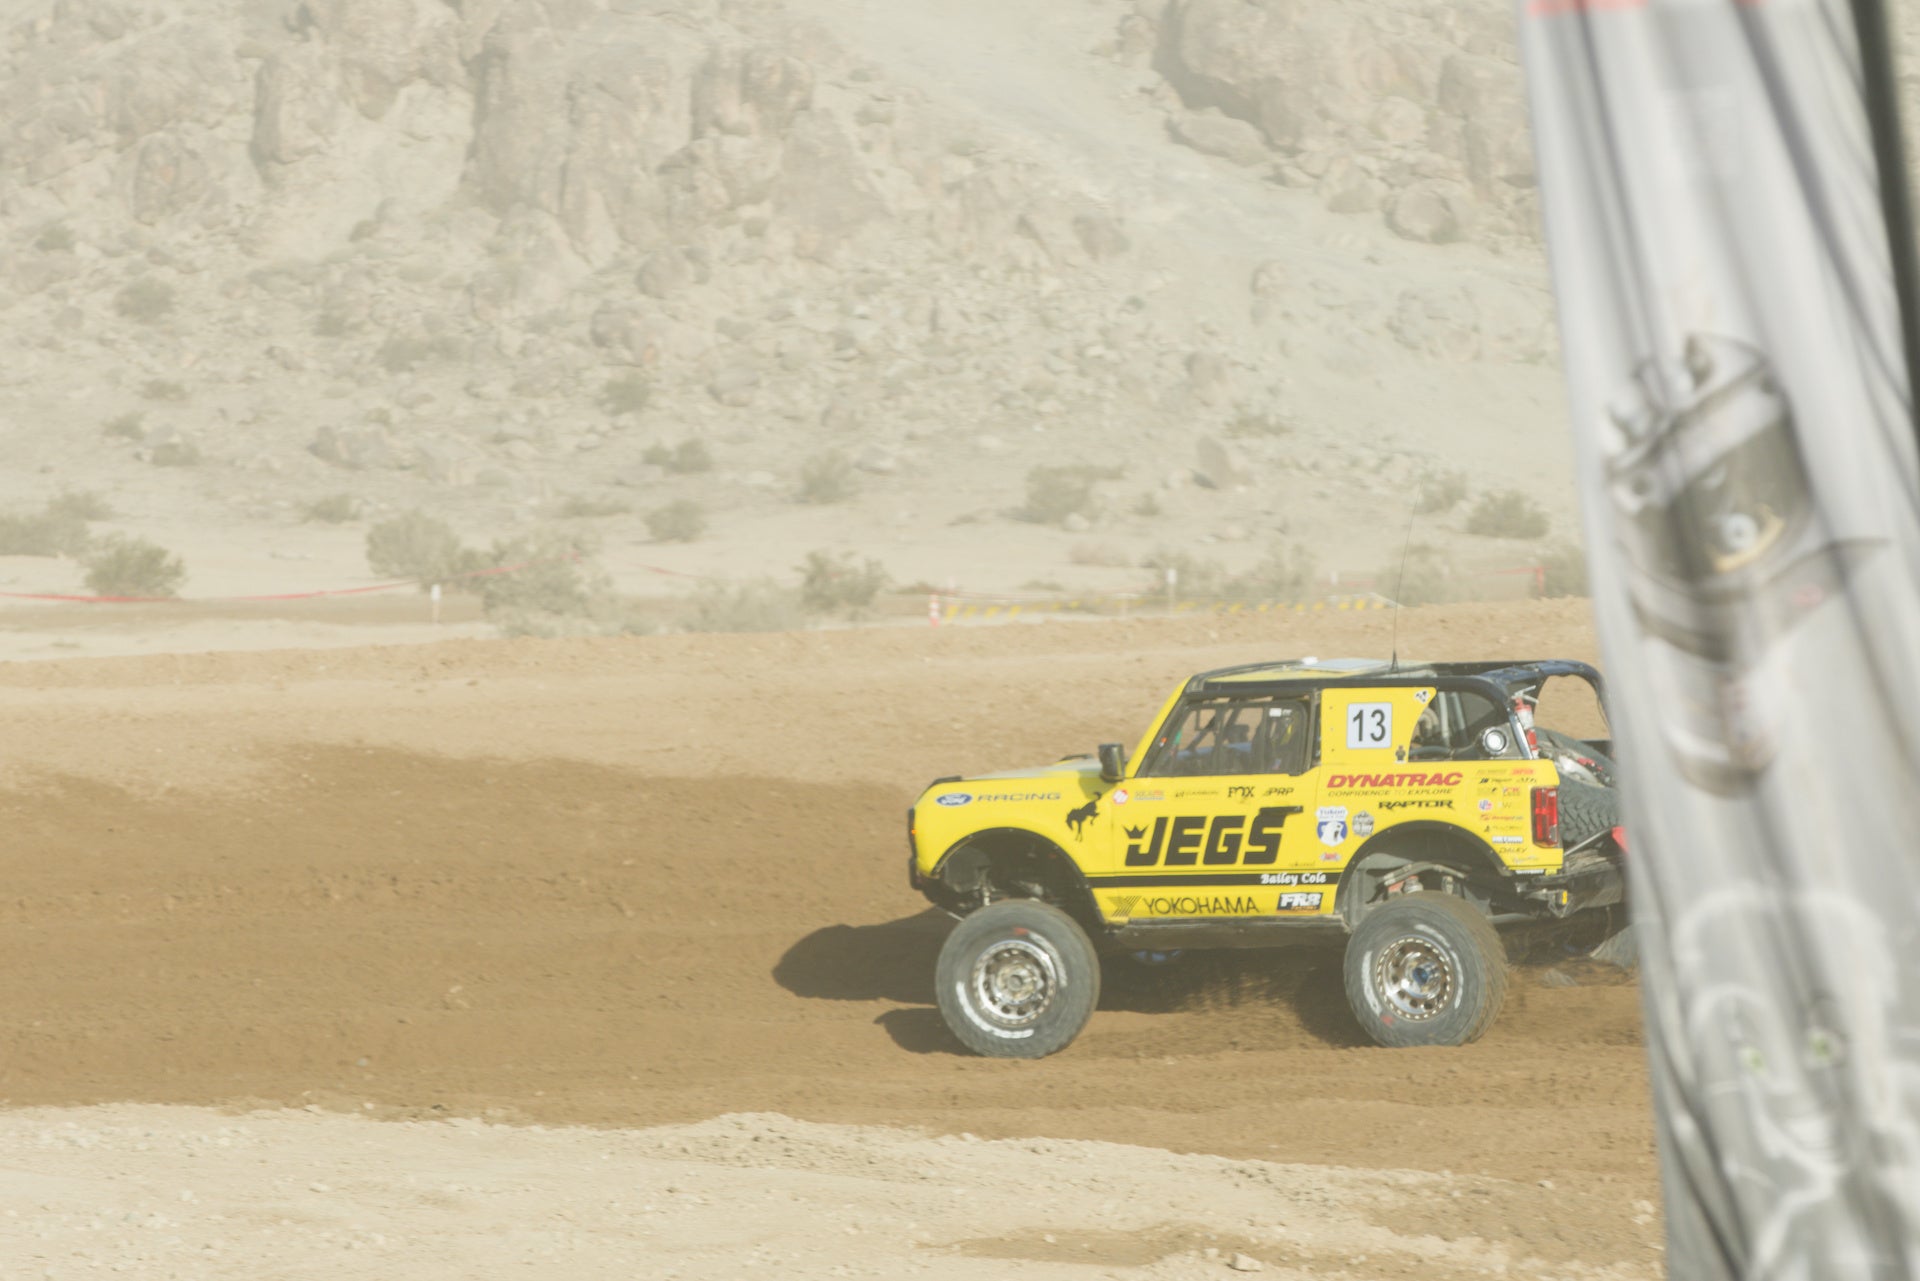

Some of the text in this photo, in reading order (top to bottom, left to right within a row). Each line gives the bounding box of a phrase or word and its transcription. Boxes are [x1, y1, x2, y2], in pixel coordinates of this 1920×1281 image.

[1352, 708, 1386, 742] 13
[1327, 772, 1463, 788] DYNATRAC
[977, 792, 1061, 802] RACING
[1267, 787, 1294, 796] PRP
[1378, 800, 1455, 810] RAPTOR
[1124, 815, 1283, 867] JEGS
[1260, 872, 1327, 887] Bailey Cole
[1143, 896, 1260, 915] YOKOHAMA
